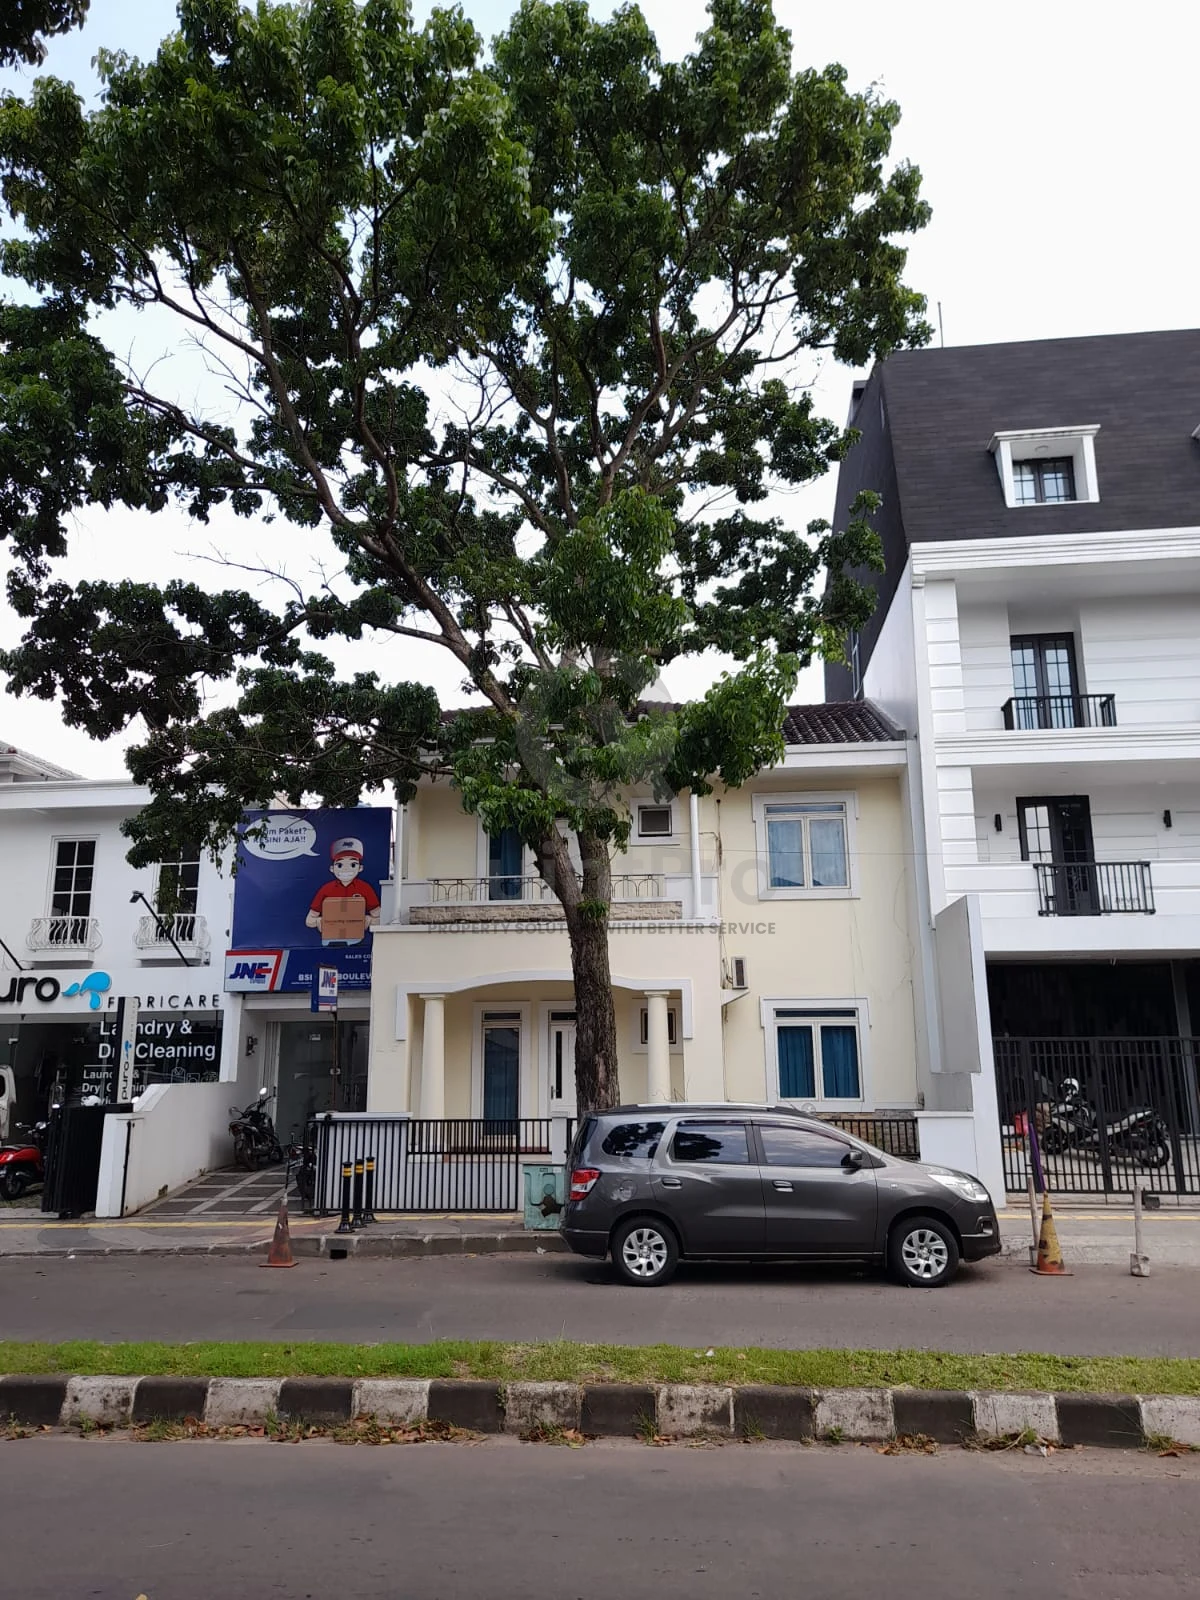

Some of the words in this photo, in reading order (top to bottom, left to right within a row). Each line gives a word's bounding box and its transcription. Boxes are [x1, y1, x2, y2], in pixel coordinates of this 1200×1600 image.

[229, 962, 272, 979] JNE
[321, 970, 337, 989] JNE
[107, 994, 220, 1009] FBRICARE
[180, 1019, 193, 1034] &
[135, 1041, 216, 1061] Cleaning
